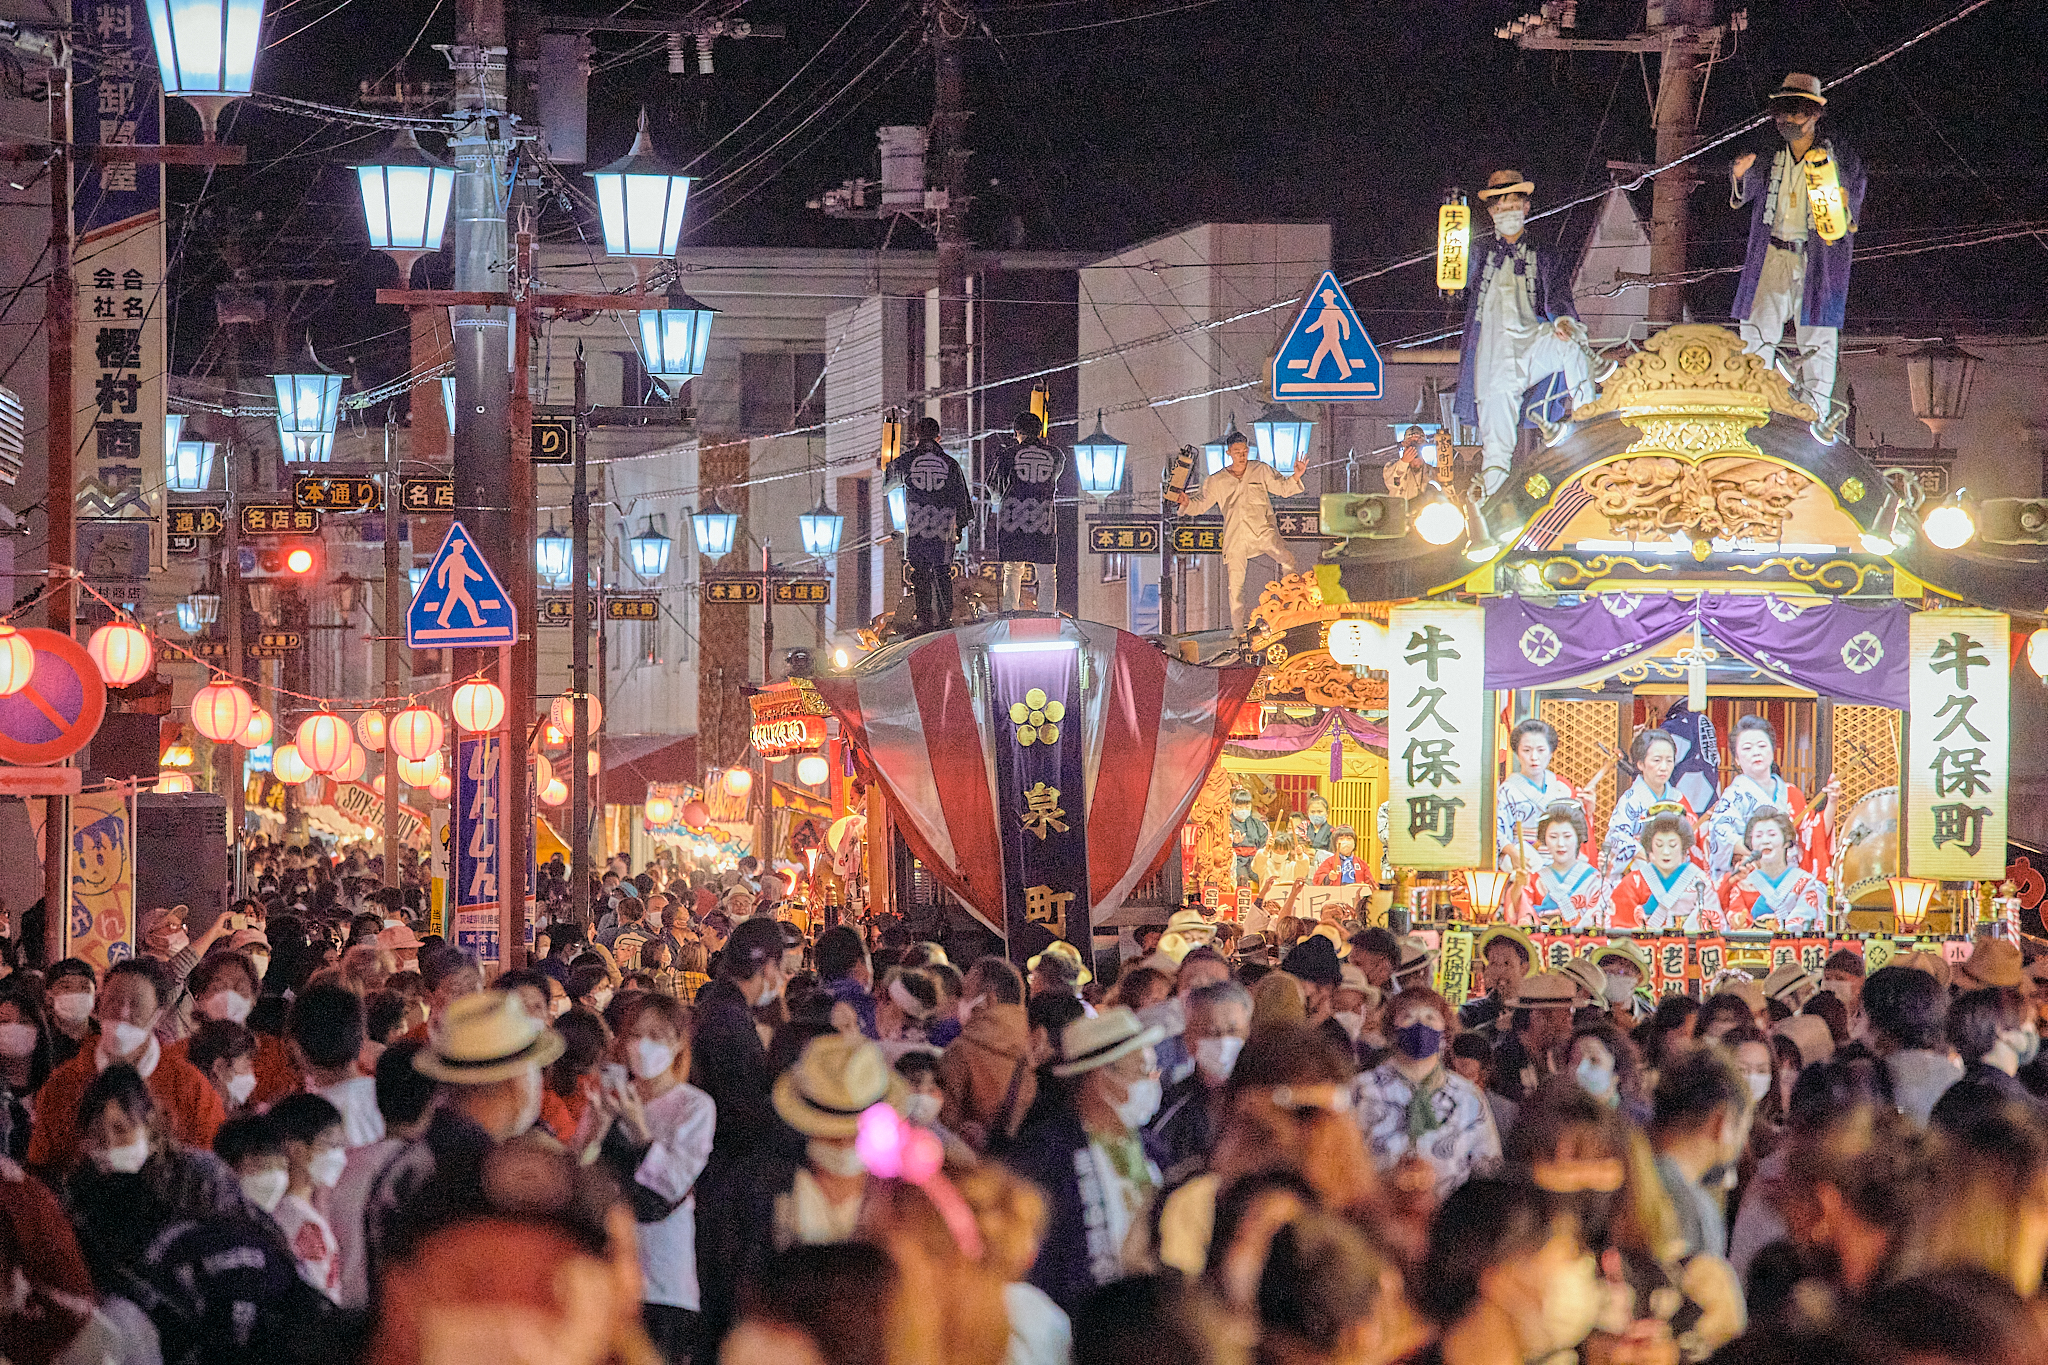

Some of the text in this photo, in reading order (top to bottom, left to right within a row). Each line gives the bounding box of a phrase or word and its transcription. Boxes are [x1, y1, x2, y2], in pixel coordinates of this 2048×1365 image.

[305, 483, 373, 504] 本通り
[167, 510, 217, 532] 通り
[248, 510, 312, 529] 名店街
[1098, 530, 1152, 548] 本通り
[712, 584, 757, 599] 本通り
[779, 585, 824, 599] 名店街
[612, 602, 653, 616] 名店街
[1402, 625, 1465, 847] 牛久保町
[1929, 632, 1994, 858] 牛久保町
[1021, 782, 1076, 939] 泉町
